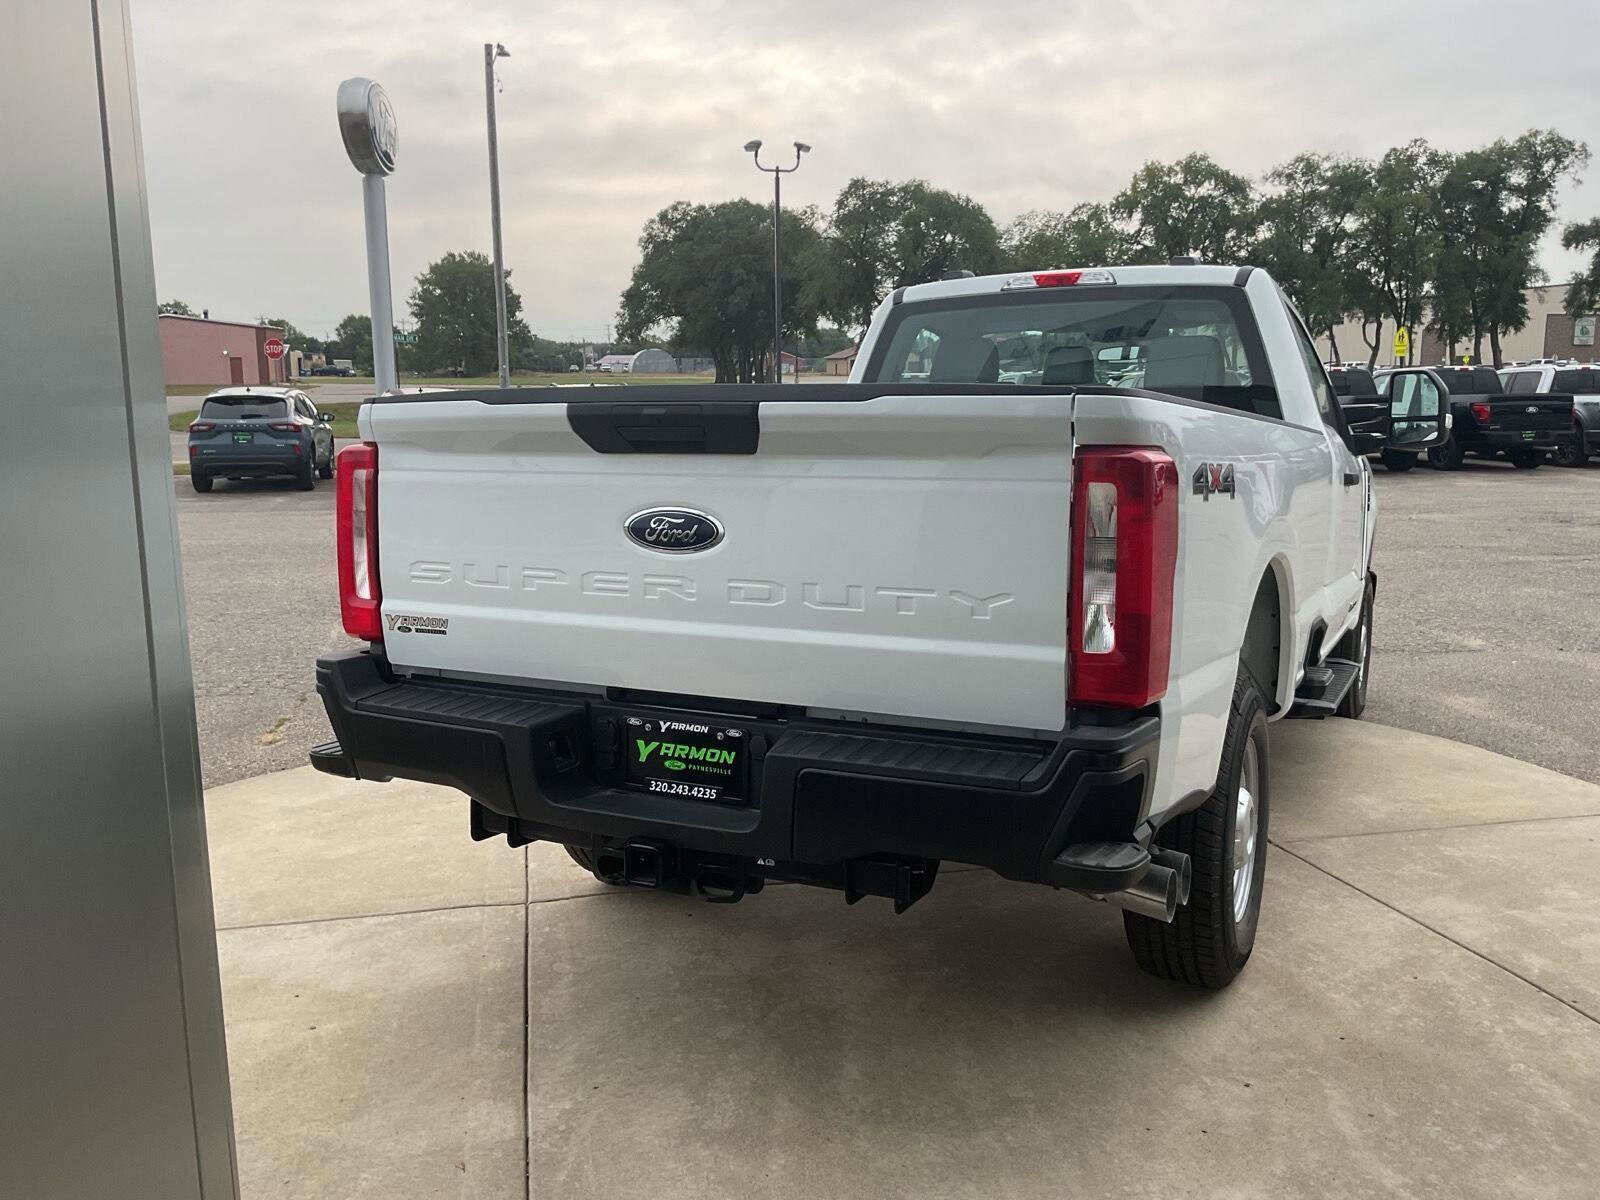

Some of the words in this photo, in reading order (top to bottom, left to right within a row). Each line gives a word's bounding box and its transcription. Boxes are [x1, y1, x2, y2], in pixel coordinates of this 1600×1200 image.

[265, 345, 283, 354] STOP
[645, 515, 698, 545] Ford
[408, 559, 698, 601] SUPER
[727, 578, 1014, 620] DUTY
[384, 613, 449, 631] YARMON
[658, 720, 709, 733] YARMON
[636, 739, 736, 765] YARMON
[688, 764, 732, 775] PAYNESVILLE
[649, 781, 717, 799] 320.243.4235
